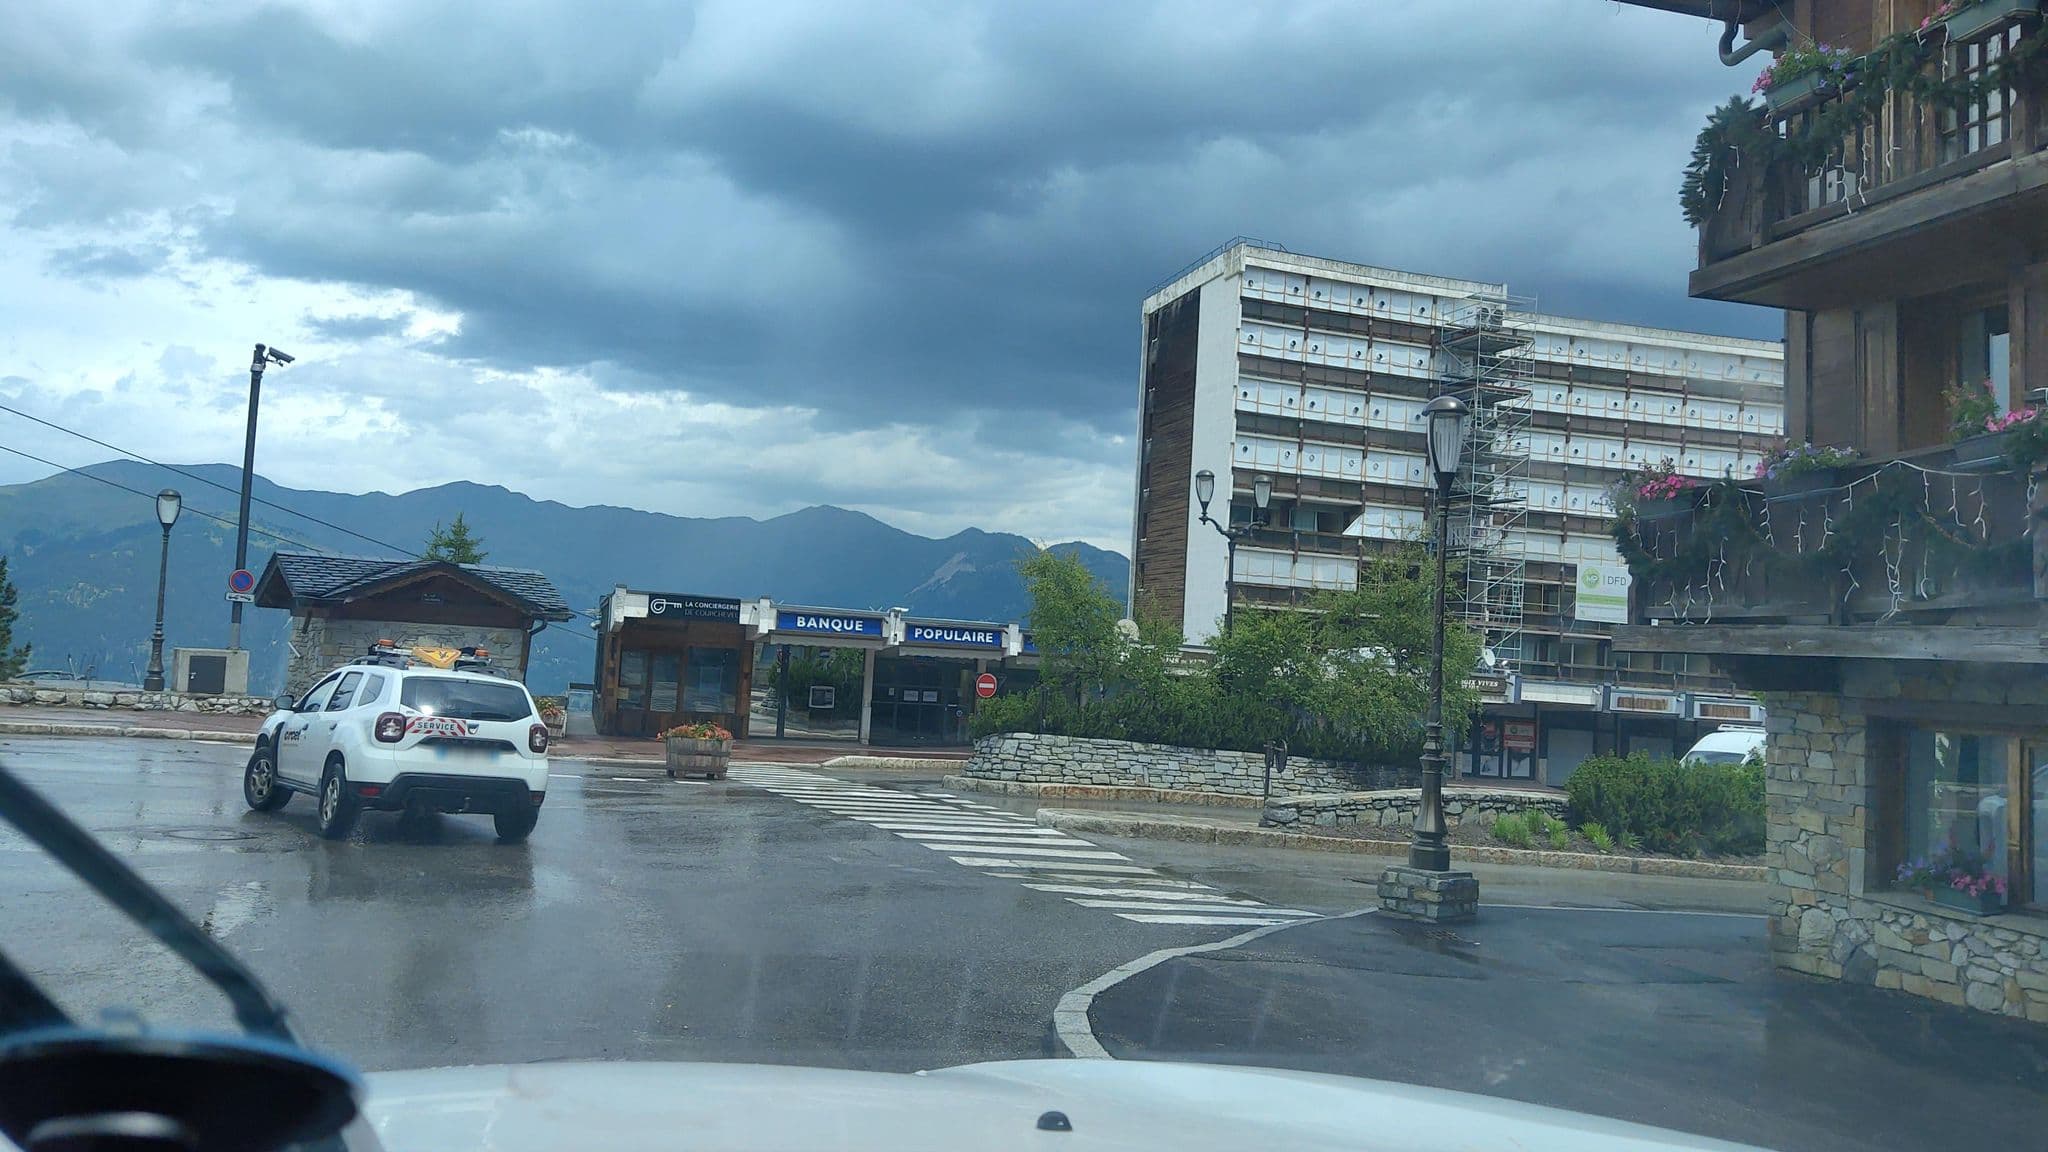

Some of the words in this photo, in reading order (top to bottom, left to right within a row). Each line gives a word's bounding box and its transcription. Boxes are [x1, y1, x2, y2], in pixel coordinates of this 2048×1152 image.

[1607, 576, 1627, 586] DFD
[694, 602, 740, 611] CONCIERGERIE
[796, 616, 864, 632] BANQUE
[914, 628, 993, 643] POPULAIRE
[417, 721, 455, 731] SERVICE
